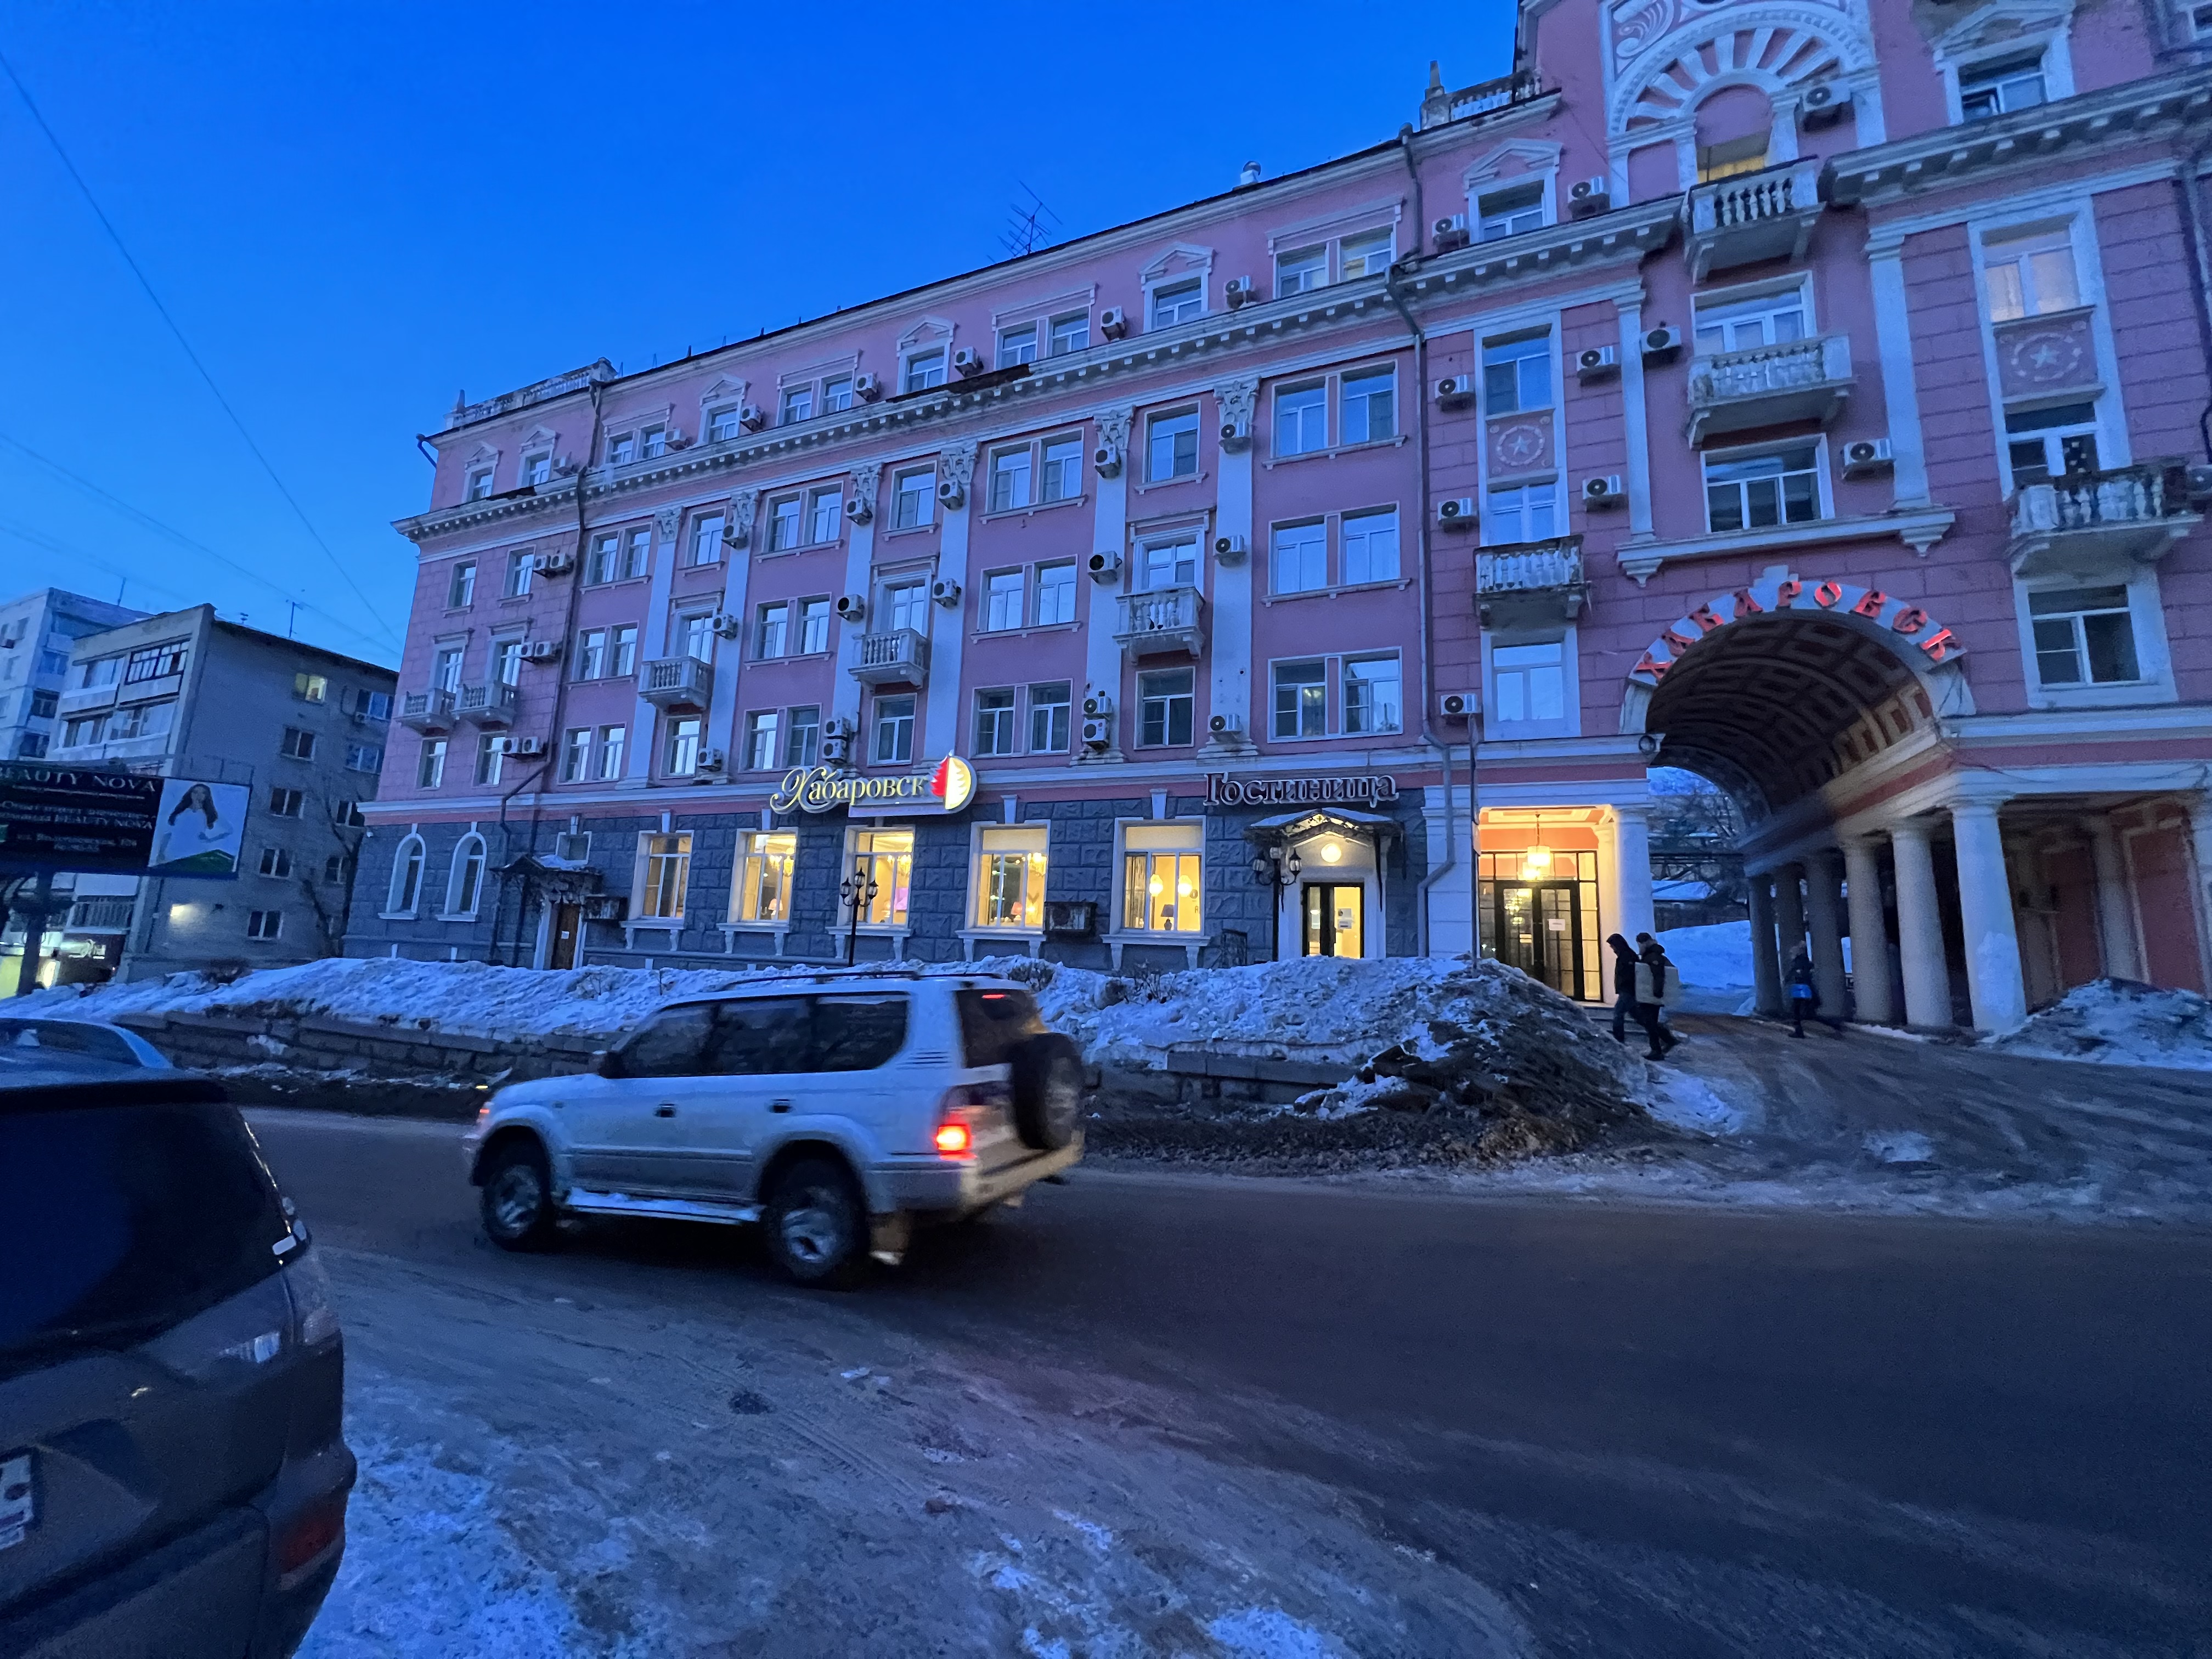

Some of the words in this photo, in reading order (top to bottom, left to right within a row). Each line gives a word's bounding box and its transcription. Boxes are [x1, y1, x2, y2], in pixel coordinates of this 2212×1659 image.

[1635, 580, 1962, 681] ХАБАРОВСК
[93, 775, 156, 792] NOVA
[770, 766, 928, 812] Хабаровск
[1203, 771, 1399, 808] Гостиница
